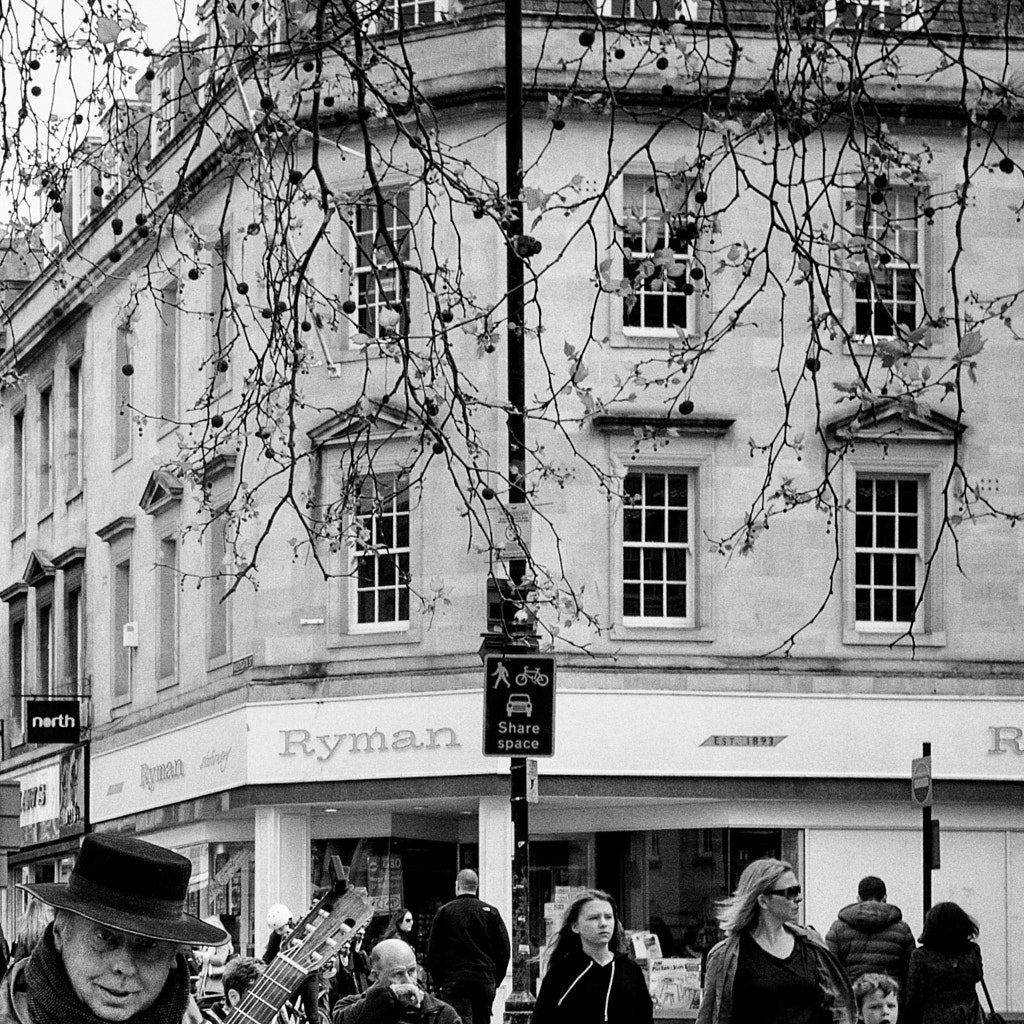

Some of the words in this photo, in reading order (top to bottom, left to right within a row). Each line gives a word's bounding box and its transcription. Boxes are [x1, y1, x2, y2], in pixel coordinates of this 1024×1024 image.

[32, 714, 75, 728] north
[498, 721, 540, 734] Share
[278, 726, 461, 761] Ryman
[497, 739, 540, 751] space
[713, 735, 739, 746] EST.
[746, 735, 775, 746] 1893
[139, 758, 185, 793] Ryman
